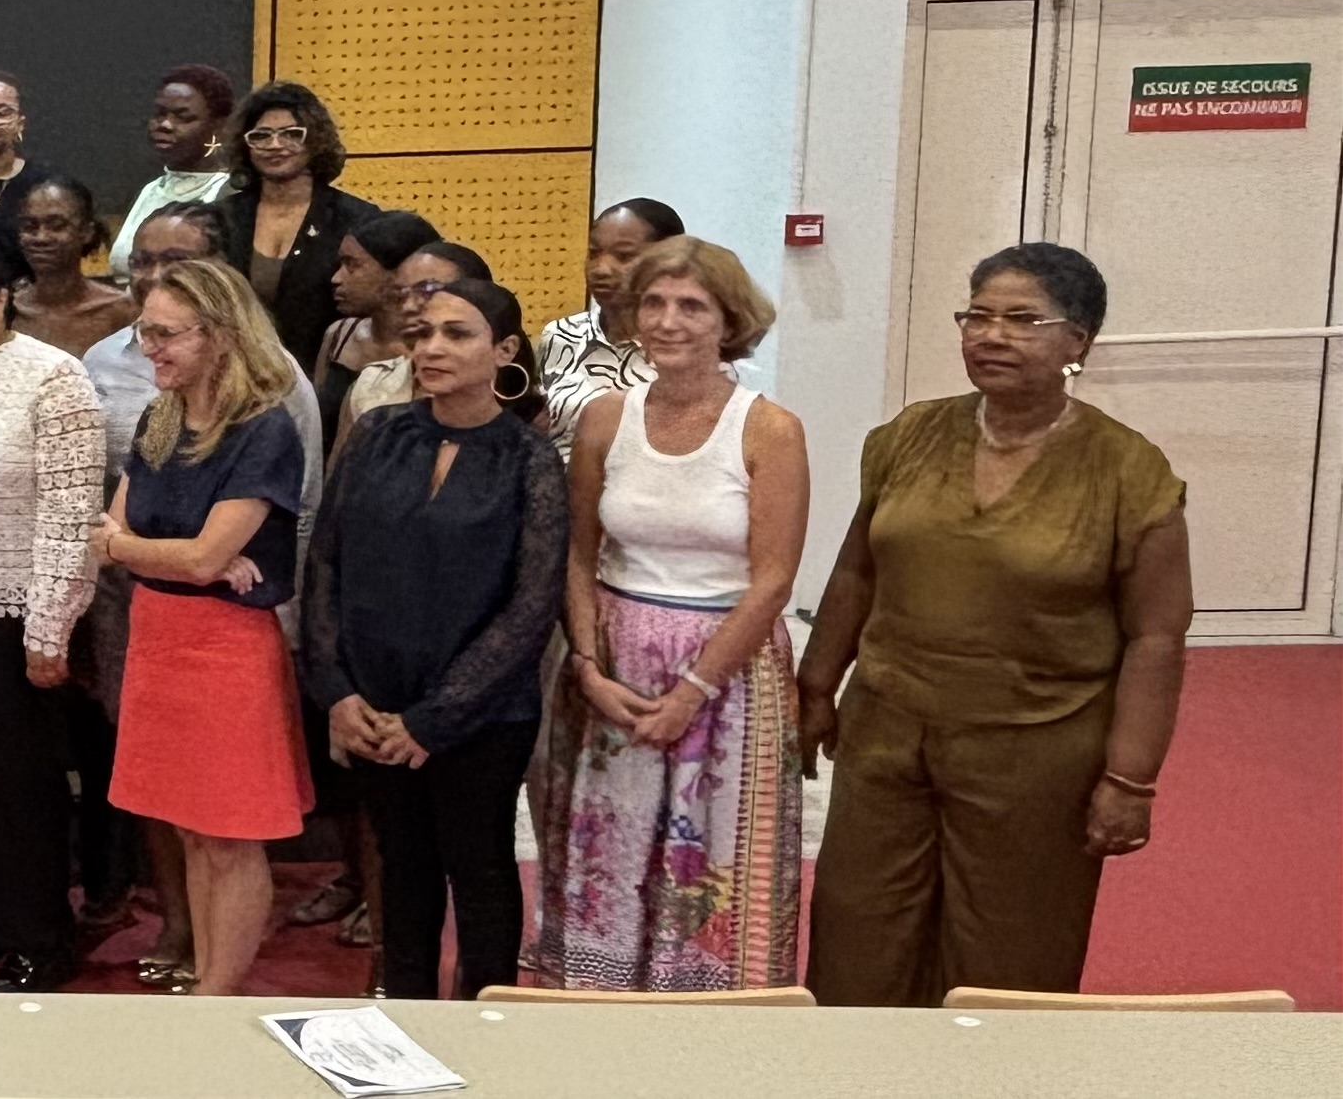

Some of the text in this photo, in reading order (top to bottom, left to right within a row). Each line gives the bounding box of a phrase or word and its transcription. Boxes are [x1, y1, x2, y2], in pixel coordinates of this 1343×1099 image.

[1142, 78, 1298, 96] ISSUE DE SECOURS
[1161, 101, 1193, 116] PAS
